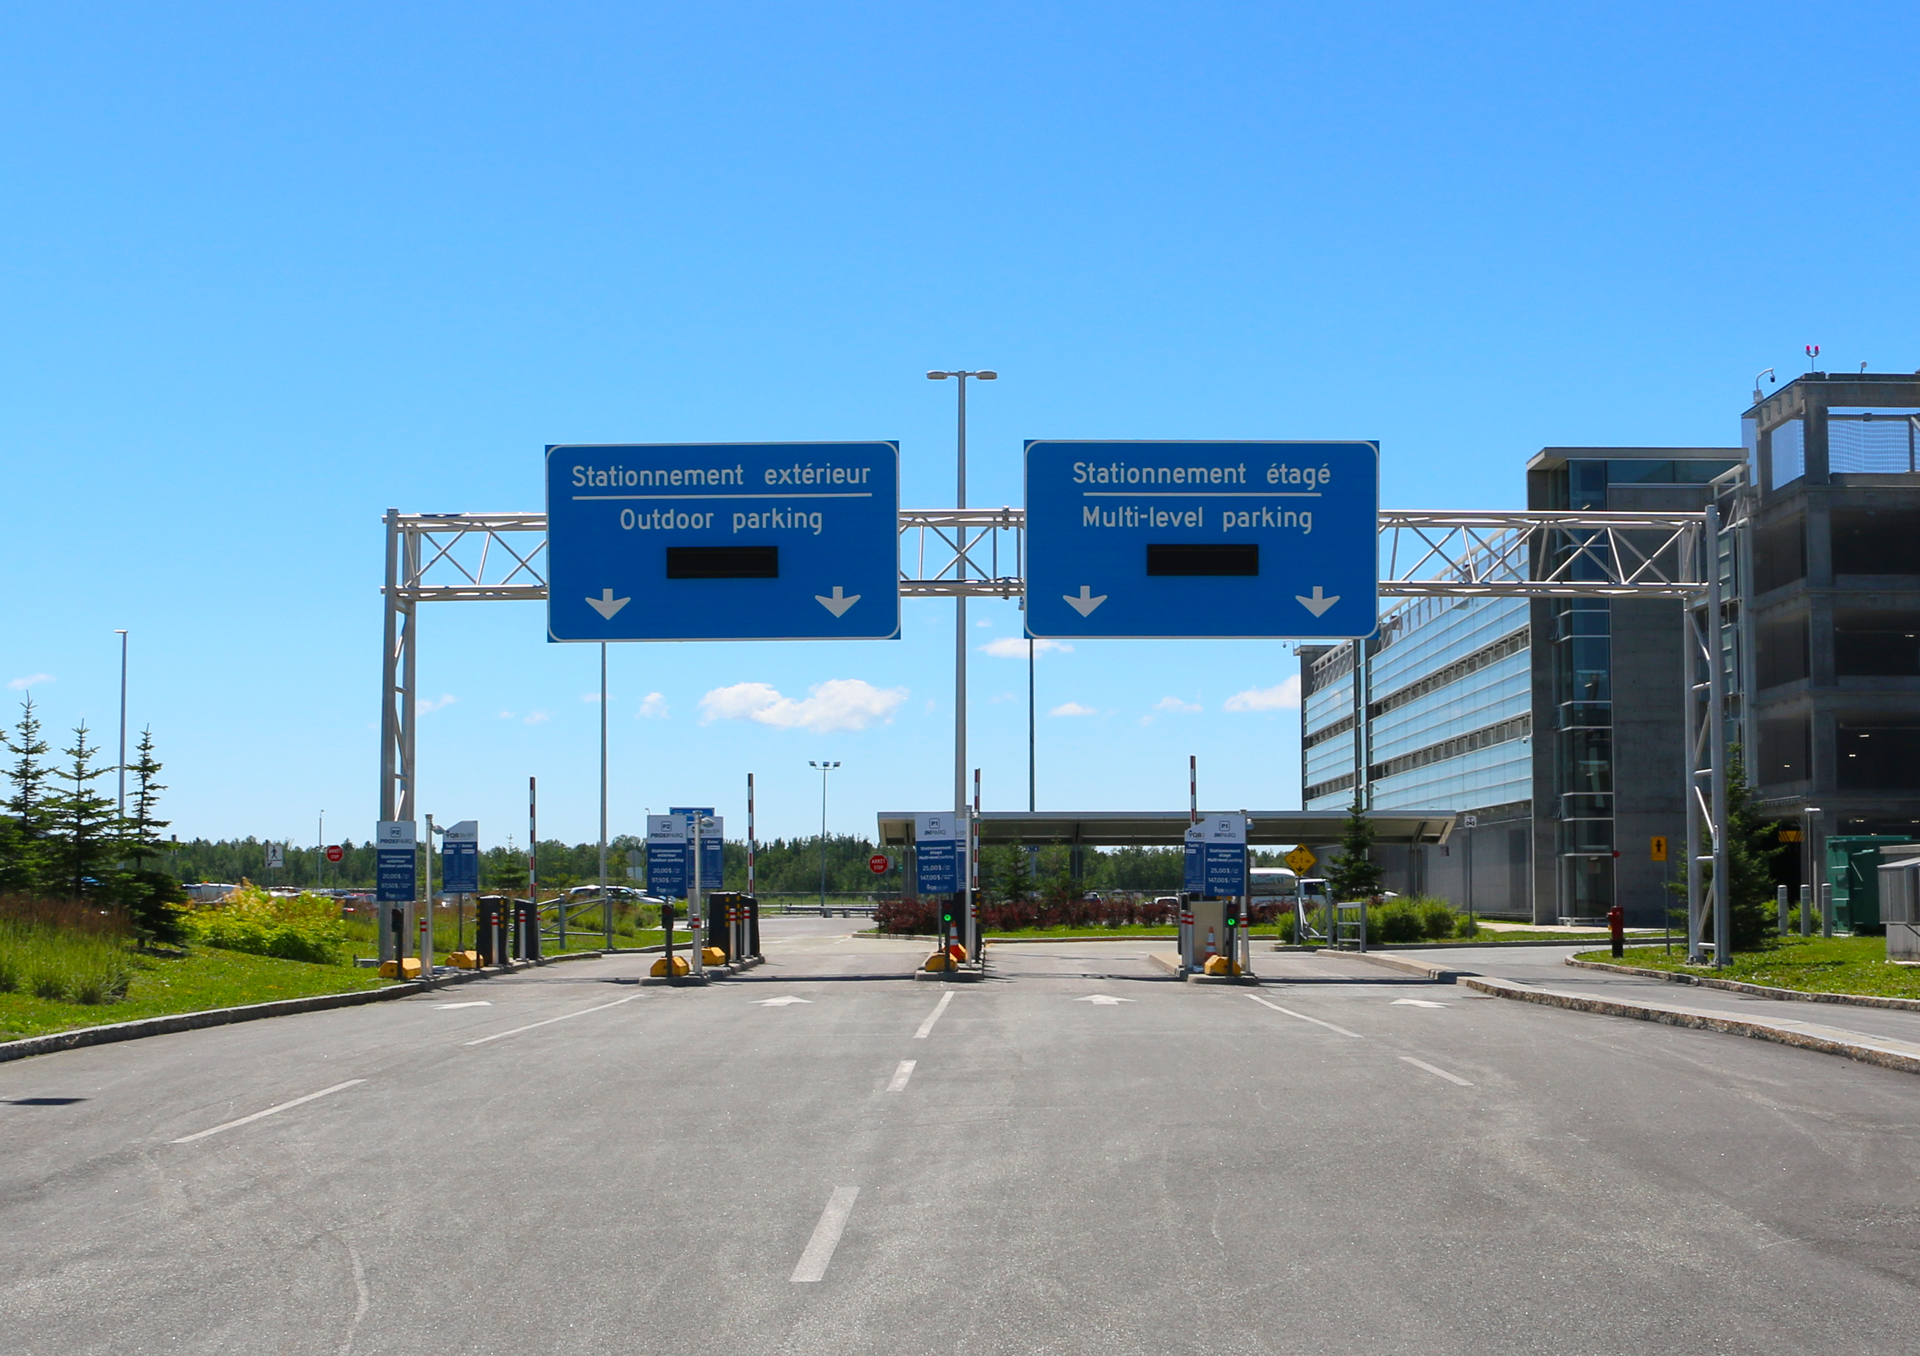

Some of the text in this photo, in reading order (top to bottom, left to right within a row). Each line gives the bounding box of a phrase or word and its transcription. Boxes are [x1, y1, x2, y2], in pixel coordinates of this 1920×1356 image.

[572, 463, 871, 487] Stationnement extérieur
[1072, 462, 1331, 491] Stationnement étagé
[620, 507, 823, 535] Outdoor parking
[1082, 506, 1312, 535] Multi-level parking
